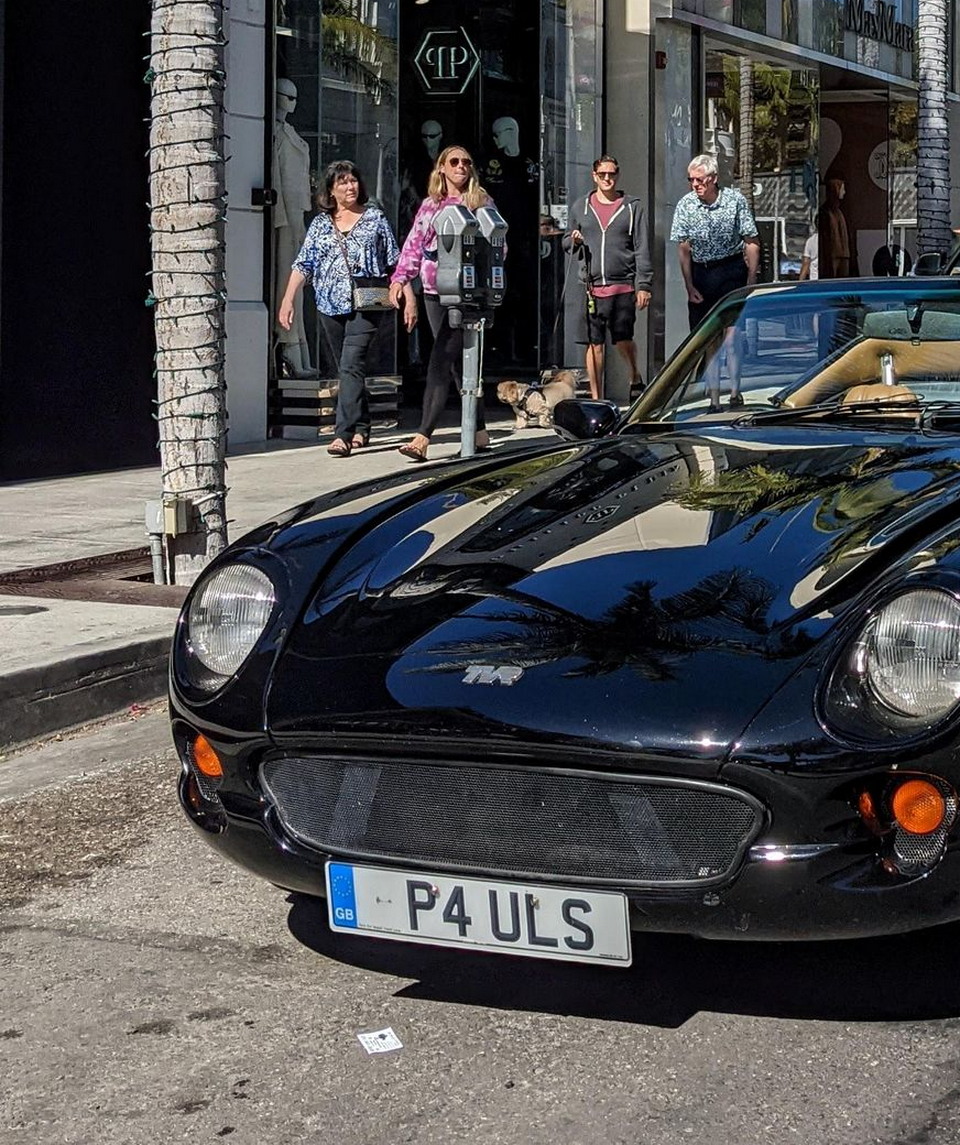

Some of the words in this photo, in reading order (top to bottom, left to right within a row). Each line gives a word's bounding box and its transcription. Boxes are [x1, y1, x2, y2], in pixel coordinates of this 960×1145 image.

[462, 665, 523, 686] TVR
[334, 907, 355, 921] GB
[405, 879, 472, 937] P4
[488, 888, 595, 951] ULS
